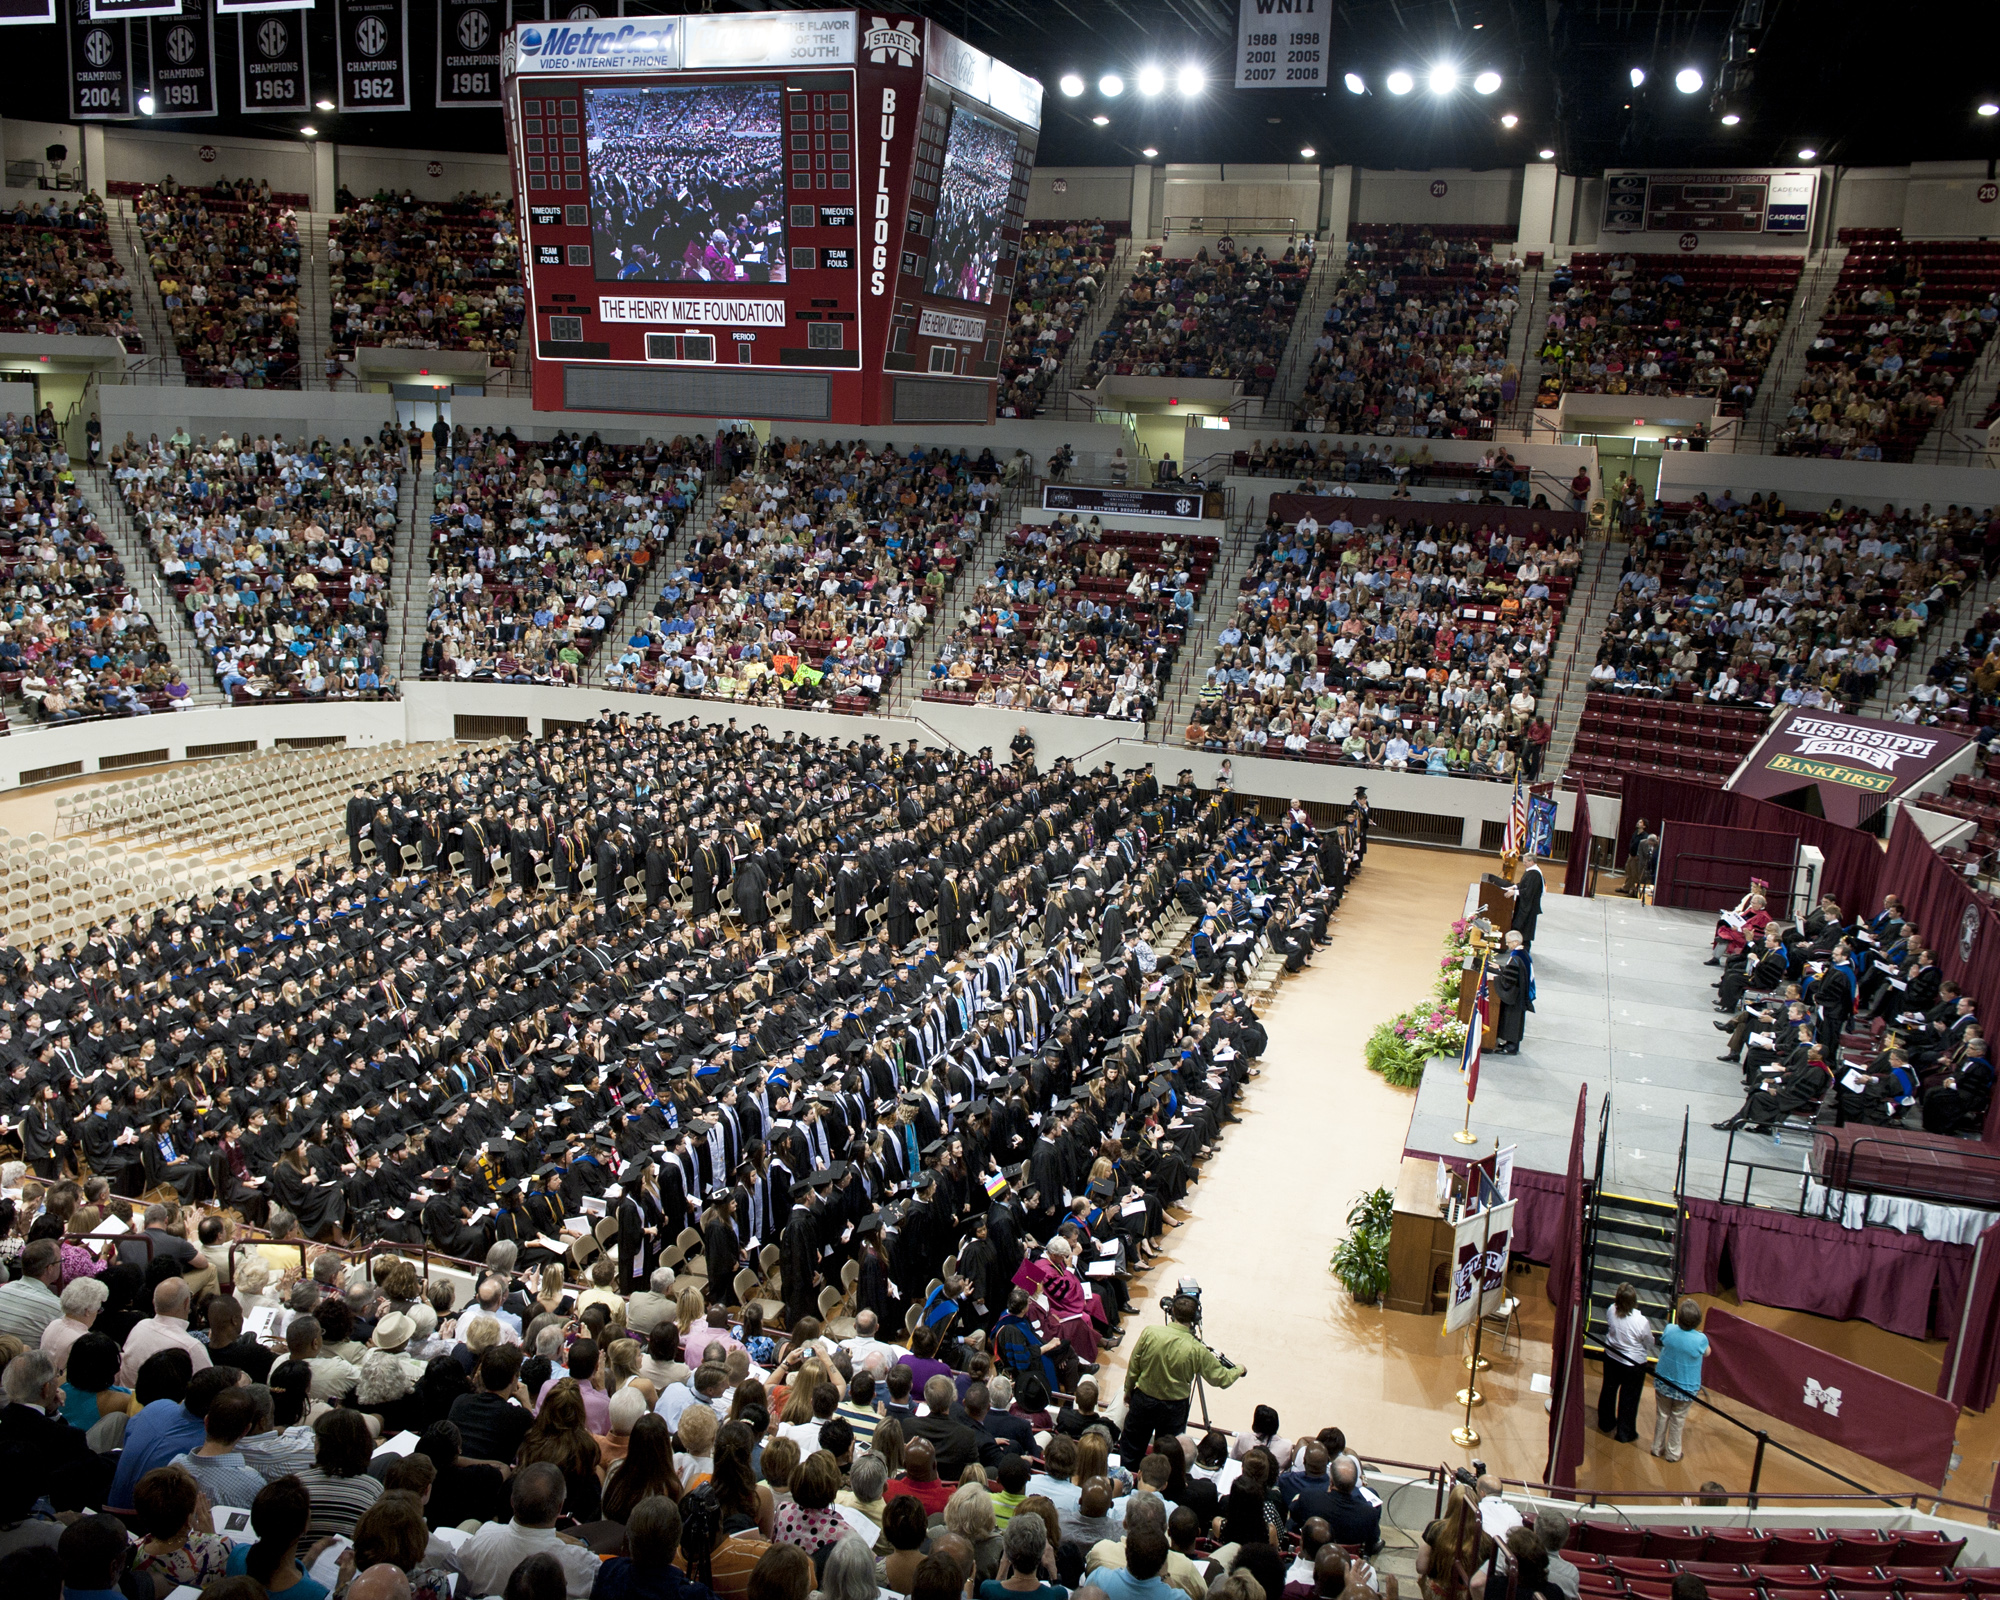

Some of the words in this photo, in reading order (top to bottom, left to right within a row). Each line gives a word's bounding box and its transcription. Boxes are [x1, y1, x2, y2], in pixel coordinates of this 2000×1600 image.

[460, 12, 488, 48] SEC
[808, 21, 850, 32] FLAVOR
[260, 20, 286, 56] SEC
[358, 18, 386, 54] SEC
[541, 24, 674, 56] MetroCast
[795, 35, 810, 44] OF
[812, 34, 835, 44] THE
[874, 32, 911, 50] STATE
[1248, 34, 1276, 46] 1988
[1290, 33, 1320, 45] 1998
[86, 31, 111, 65] SEC
[168, 28, 194, 62] SEC
[790, 46, 839, 58] SOUTH!
[1246, 51, 1276, 63] 2001
[1288, 50, 1320, 62] 2005
[346, 60, 398, 72] CHAMPIONS
[446, 55, 500, 66] CHAMPIONS
[540, 58, 569, 68] VIDEO
[576, 57, 626, 68] INTERNET
[632, 56, 668, 66] PHONE
[158, 68, 204, 80] CHAMPIONS
[250, 62, 298, 74] CHAMPIONS
[1244, 69, 1276, 80] 2007
[1286, 68, 1318, 80] 2008
[76, 71, 122, 81] CHAMPIONS
[256, 79, 294, 100] 1963
[354, 78, 394, 98] 1962
[452, 73, 490, 94] 1961
[80, 88, 120, 107] 2004
[164, 85, 199, 104] 1991
[200, 148, 215, 159] 205
[871, 88, 896, 296] BULLDOGS
[1433, 184, 1445, 194] 211
[1980, 187, 1997, 199] 213
[821, 208, 854, 216] TIMEOUTS
[539, 216, 554, 224] LEFT
[1218, 240, 1234, 250] 210
[1681, 236, 1696, 248] 212
[540, 256, 559, 264] FOULS
[829, 250, 846, 258] TEAM
[827, 260, 848, 268] FOULS
[602, 300, 626, 318] THE
[628, 300, 669, 320] HENRY
[672, 302, 701, 320] MIZE
[704, 302, 784, 322] FOUNDATION
[1176, 498, 1192, 513] SEC
[1787, 719, 1936, 756] MISSISSIPPI
[1815, 742, 1880, 763] STATE
[1810, 1390, 1834, 1404] STATE
